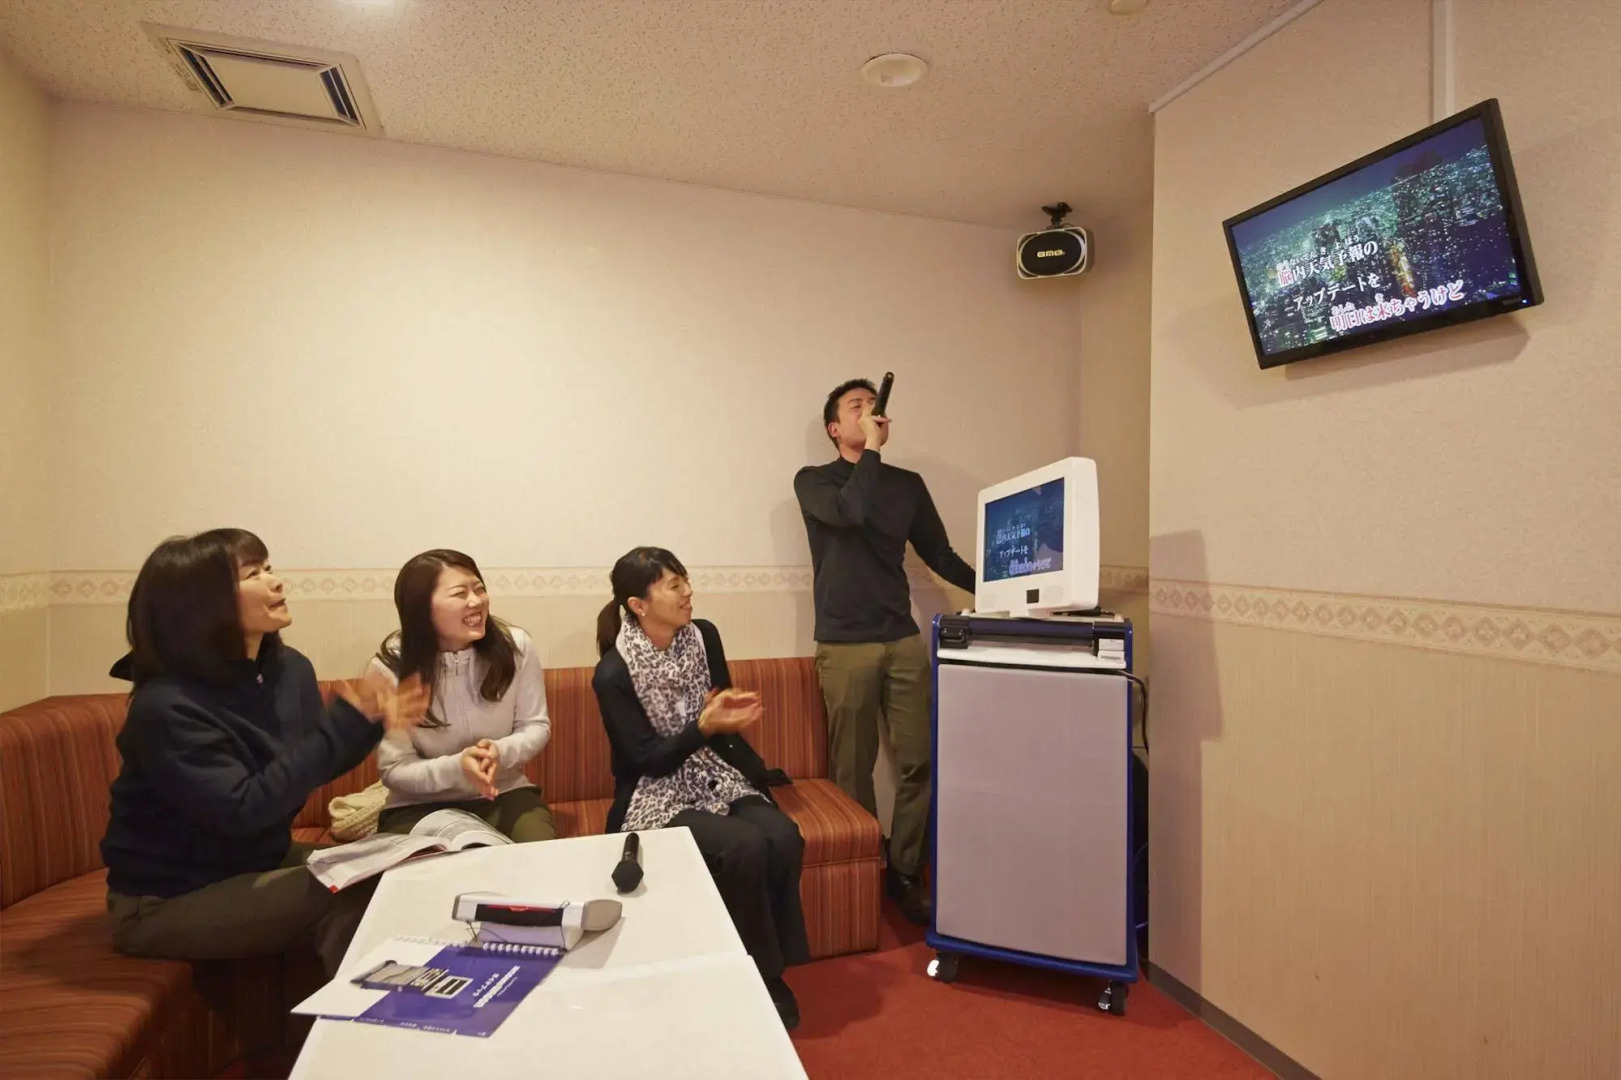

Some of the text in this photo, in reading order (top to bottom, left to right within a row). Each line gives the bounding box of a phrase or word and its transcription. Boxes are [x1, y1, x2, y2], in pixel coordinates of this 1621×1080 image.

[1278, 241, 1378, 287] 脳内天気予報の
[1293, 272, 1381, 310] アップデートを
[1329, 280, 1466, 332] 明日は来ちゃうけど
